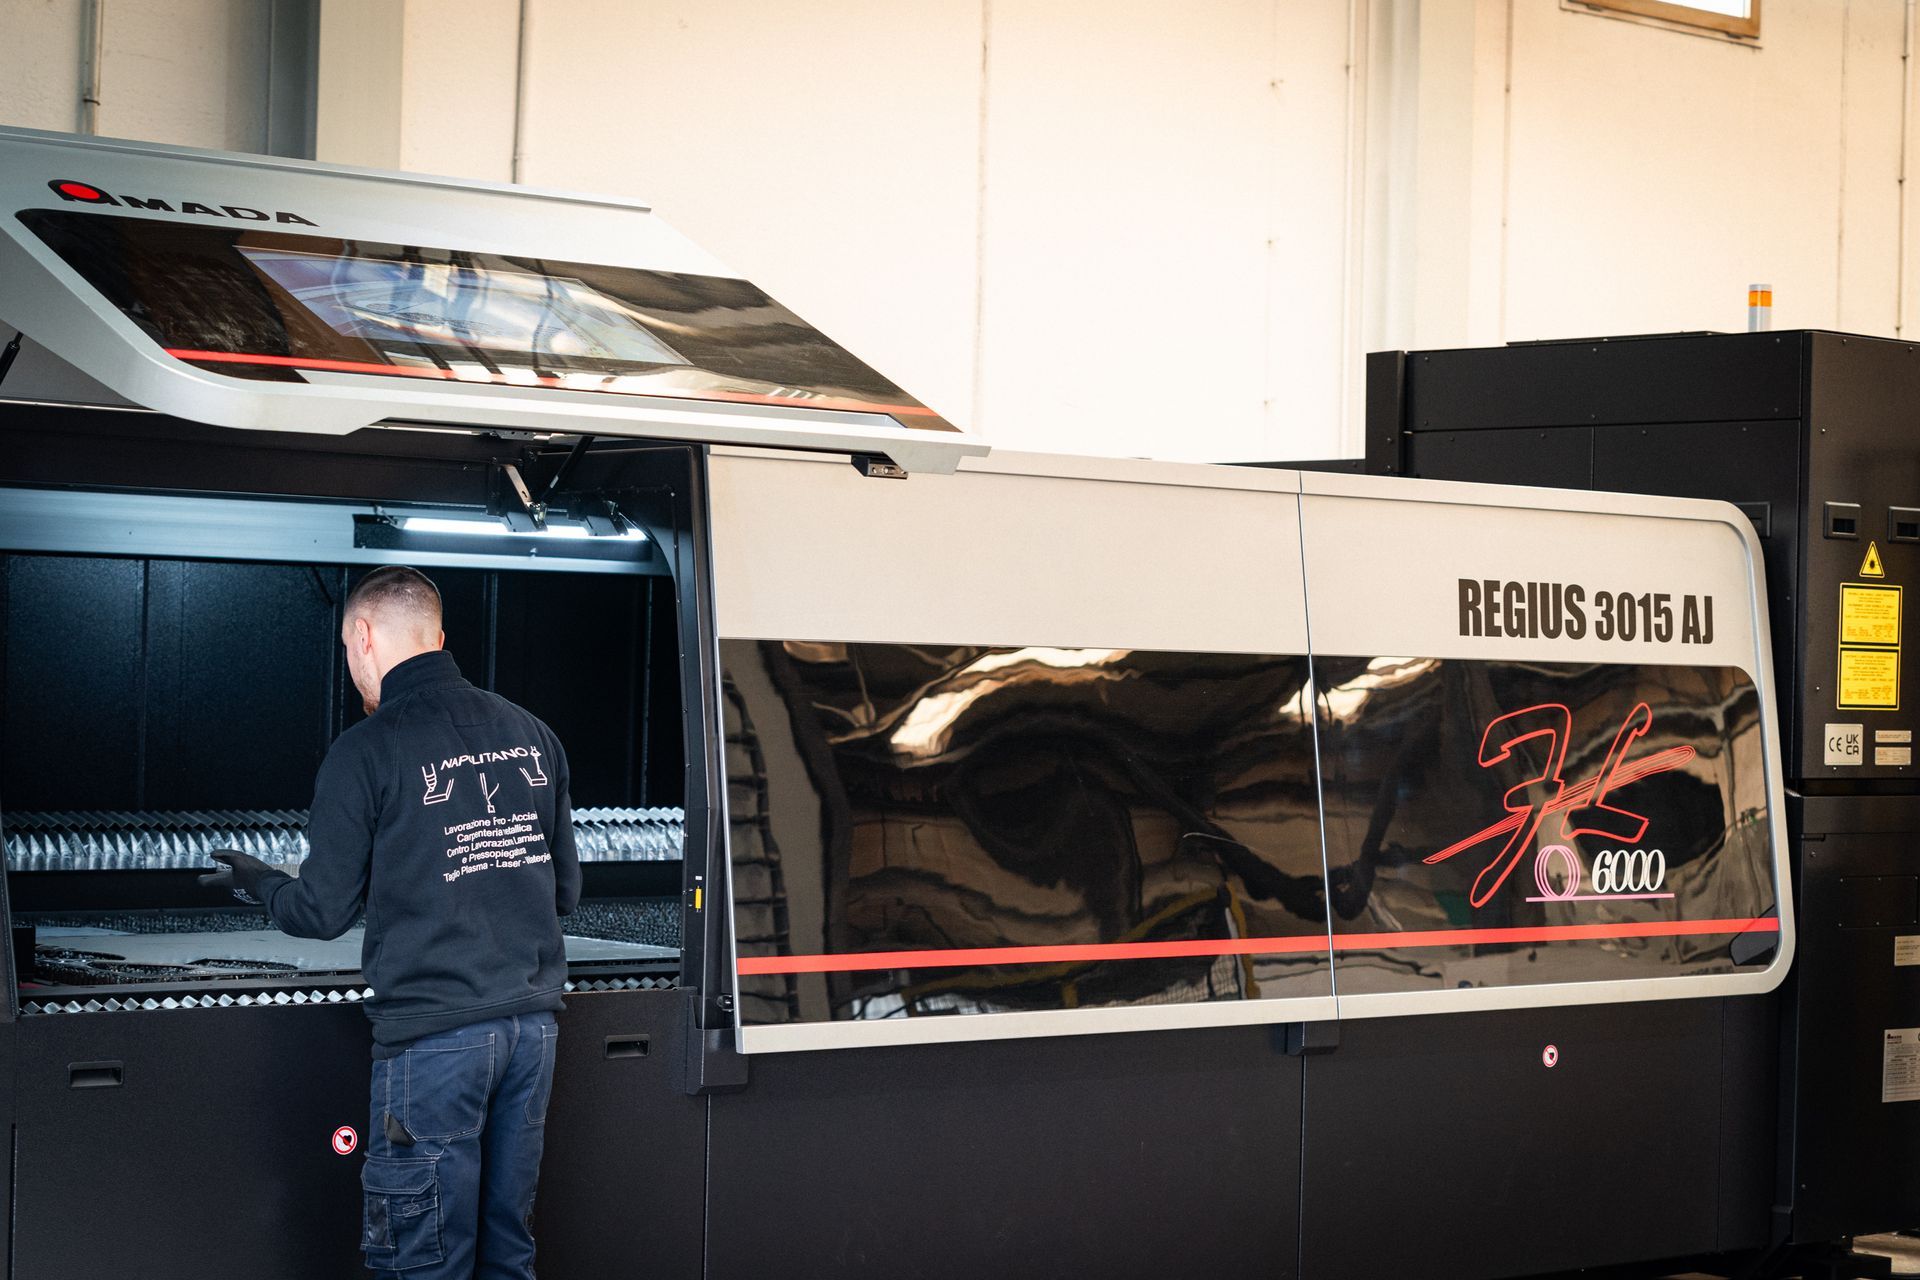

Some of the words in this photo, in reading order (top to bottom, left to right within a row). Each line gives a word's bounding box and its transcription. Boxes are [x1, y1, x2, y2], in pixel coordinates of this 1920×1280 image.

[48, 178, 320, 227] AMADA
[1458, 578, 1587, 641] REGIUS
[1594, 591, 1674, 643] 3015
[1681, 595, 1714, 645] AJ
[1828, 736, 1842, 752] CE
[1846, 733, 1859, 745] UK
[1846, 744, 1859, 756] CA
[444, 819, 491, 836] Lavorazione
[456, 827, 504, 843] Carpenteria
[446, 845, 470, 858] Centro
[461, 856, 467, 864] e
[461, 862, 488, 876] Plasma
[496, 859, 521, 868] Laser
[1592, 849, 1666, 894] 6000
